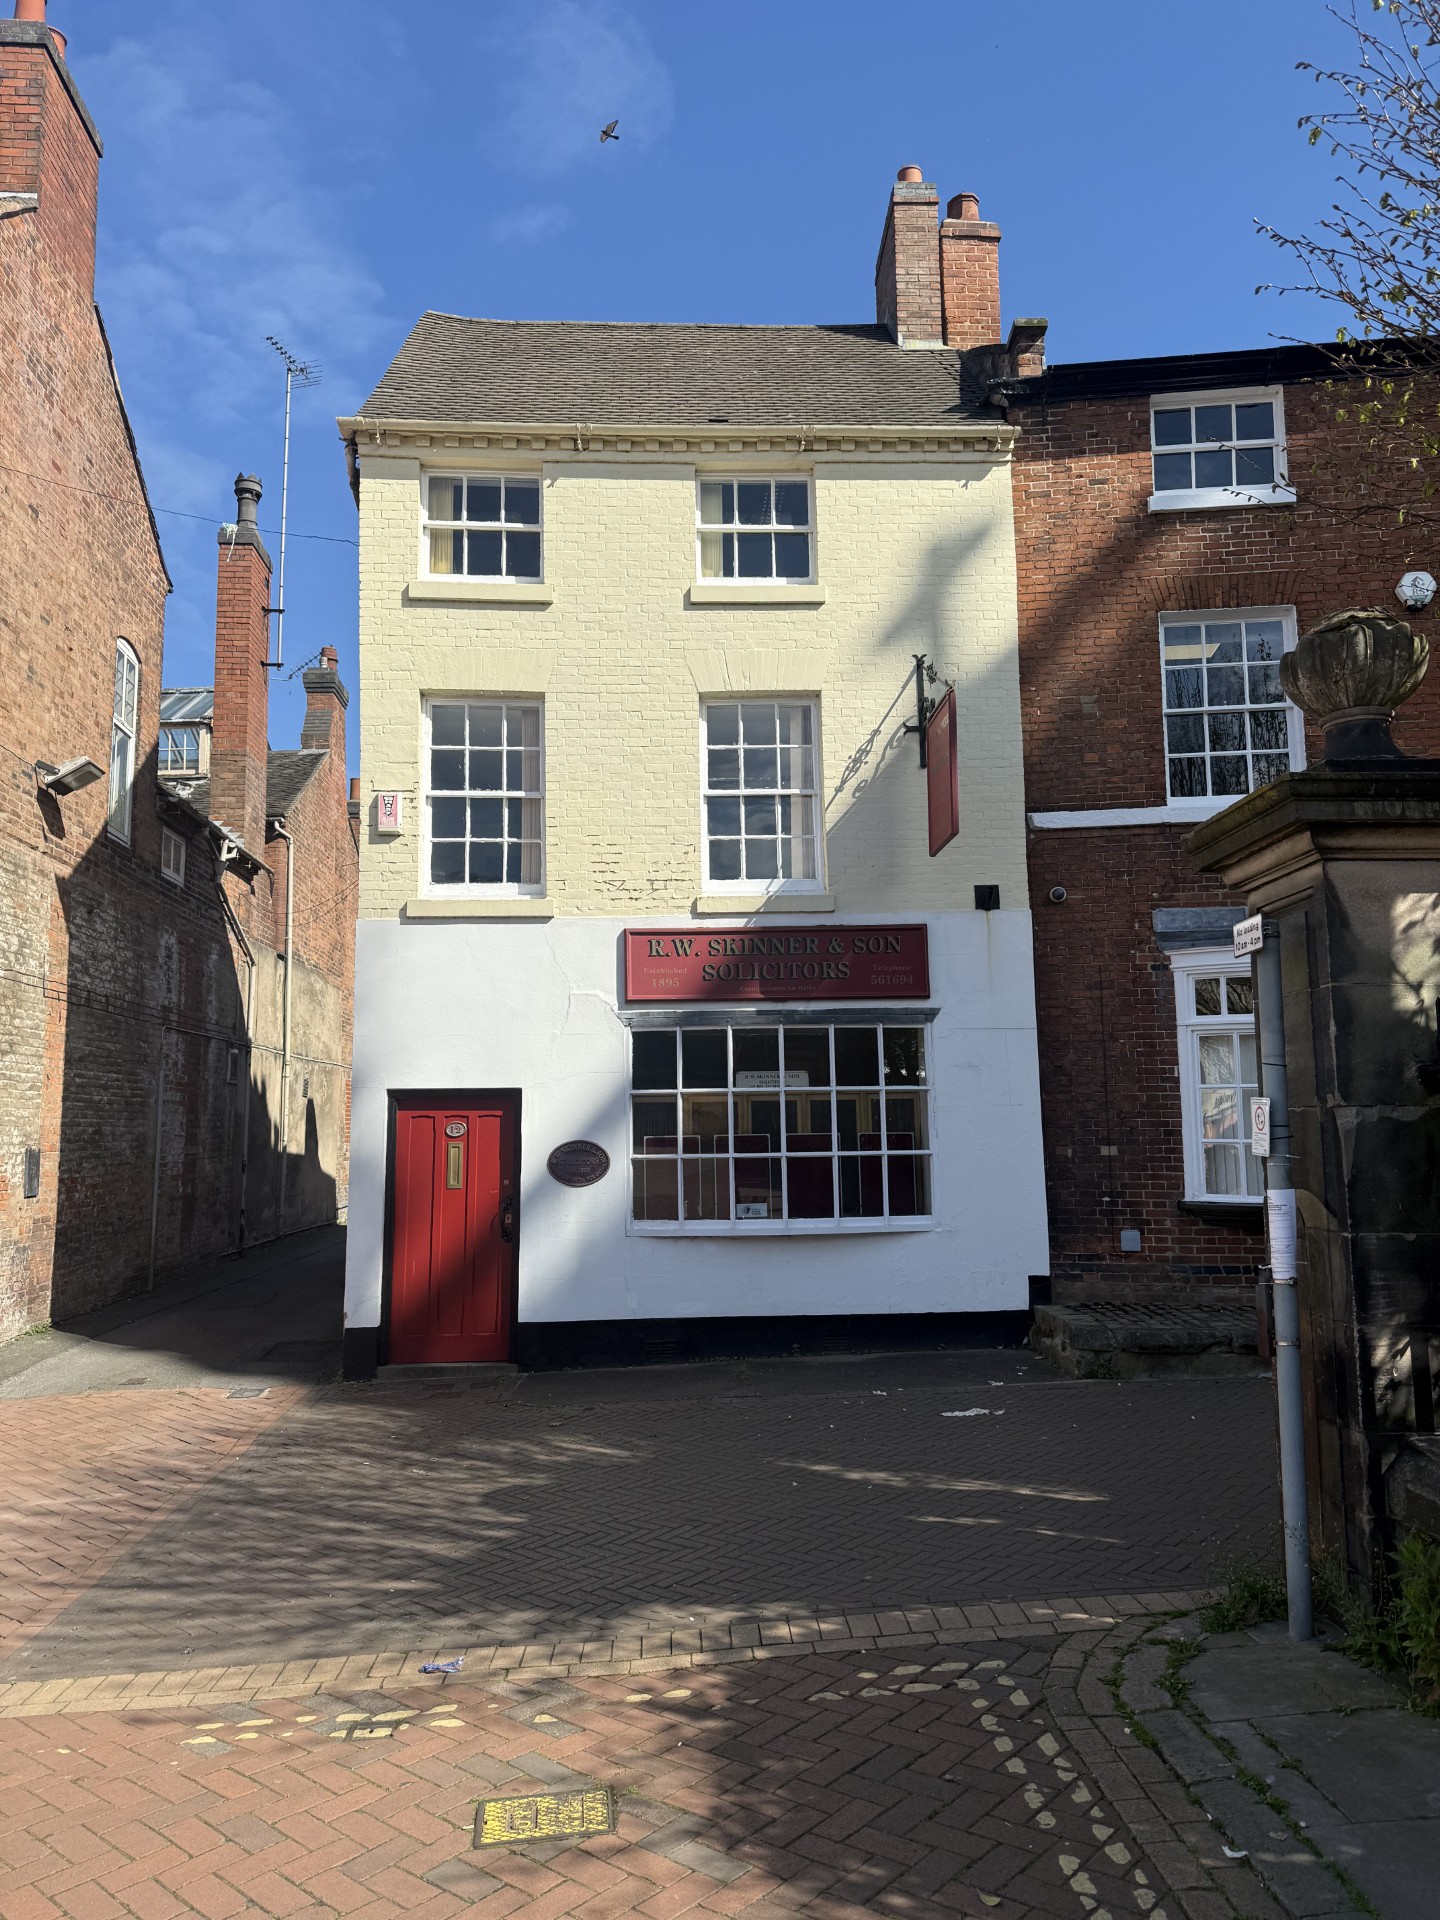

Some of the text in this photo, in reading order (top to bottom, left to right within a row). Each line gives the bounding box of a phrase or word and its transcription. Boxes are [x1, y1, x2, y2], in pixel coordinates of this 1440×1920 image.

[1236, 928, 1242, 937] No
[648, 935, 902, 957] R.W. SKINNER & SON
[702, 961, 851, 982] SOLICITORS
[872, 964, 912, 972] Telephone
[651, 978, 680, 988] 1895
[870, 974, 914, 985] 561694
[450, 1126, 460, 1134] 12
